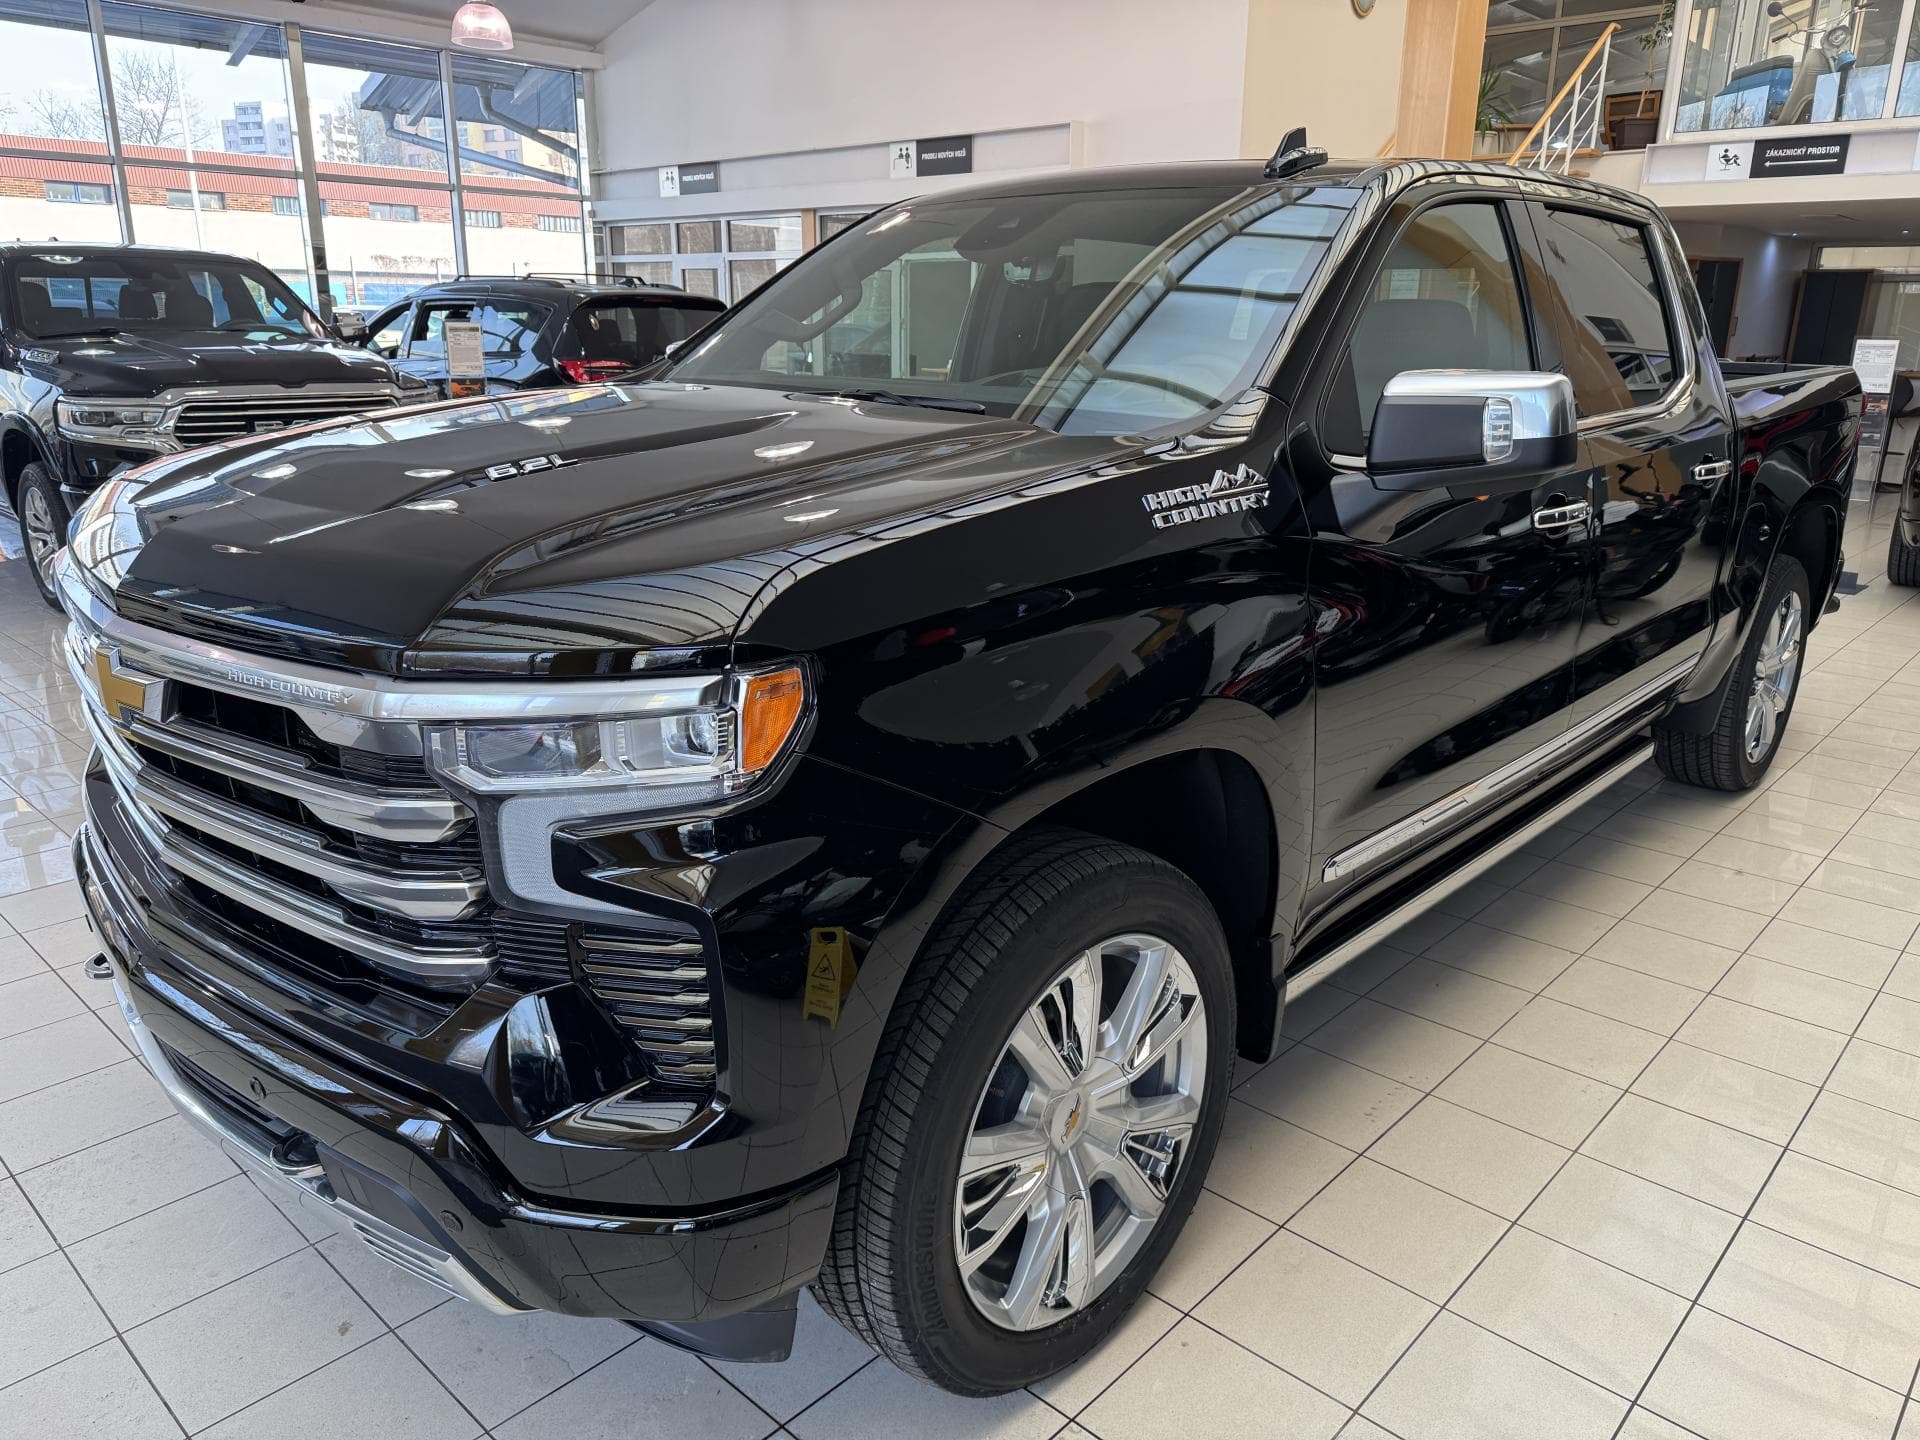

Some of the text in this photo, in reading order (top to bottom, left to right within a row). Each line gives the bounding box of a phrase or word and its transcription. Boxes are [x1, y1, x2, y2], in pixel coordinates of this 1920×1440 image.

[1765, 146, 1840, 157] ZÁKAZNICKÝ PROSTOR
[1142, 483, 1213, 512] HIGH
[1151, 490, 1270, 529] COUNTRY
[228, 670, 353, 704] HIGH COUNTRY
[915, 1191, 949, 1335] BRIDGESTONE
